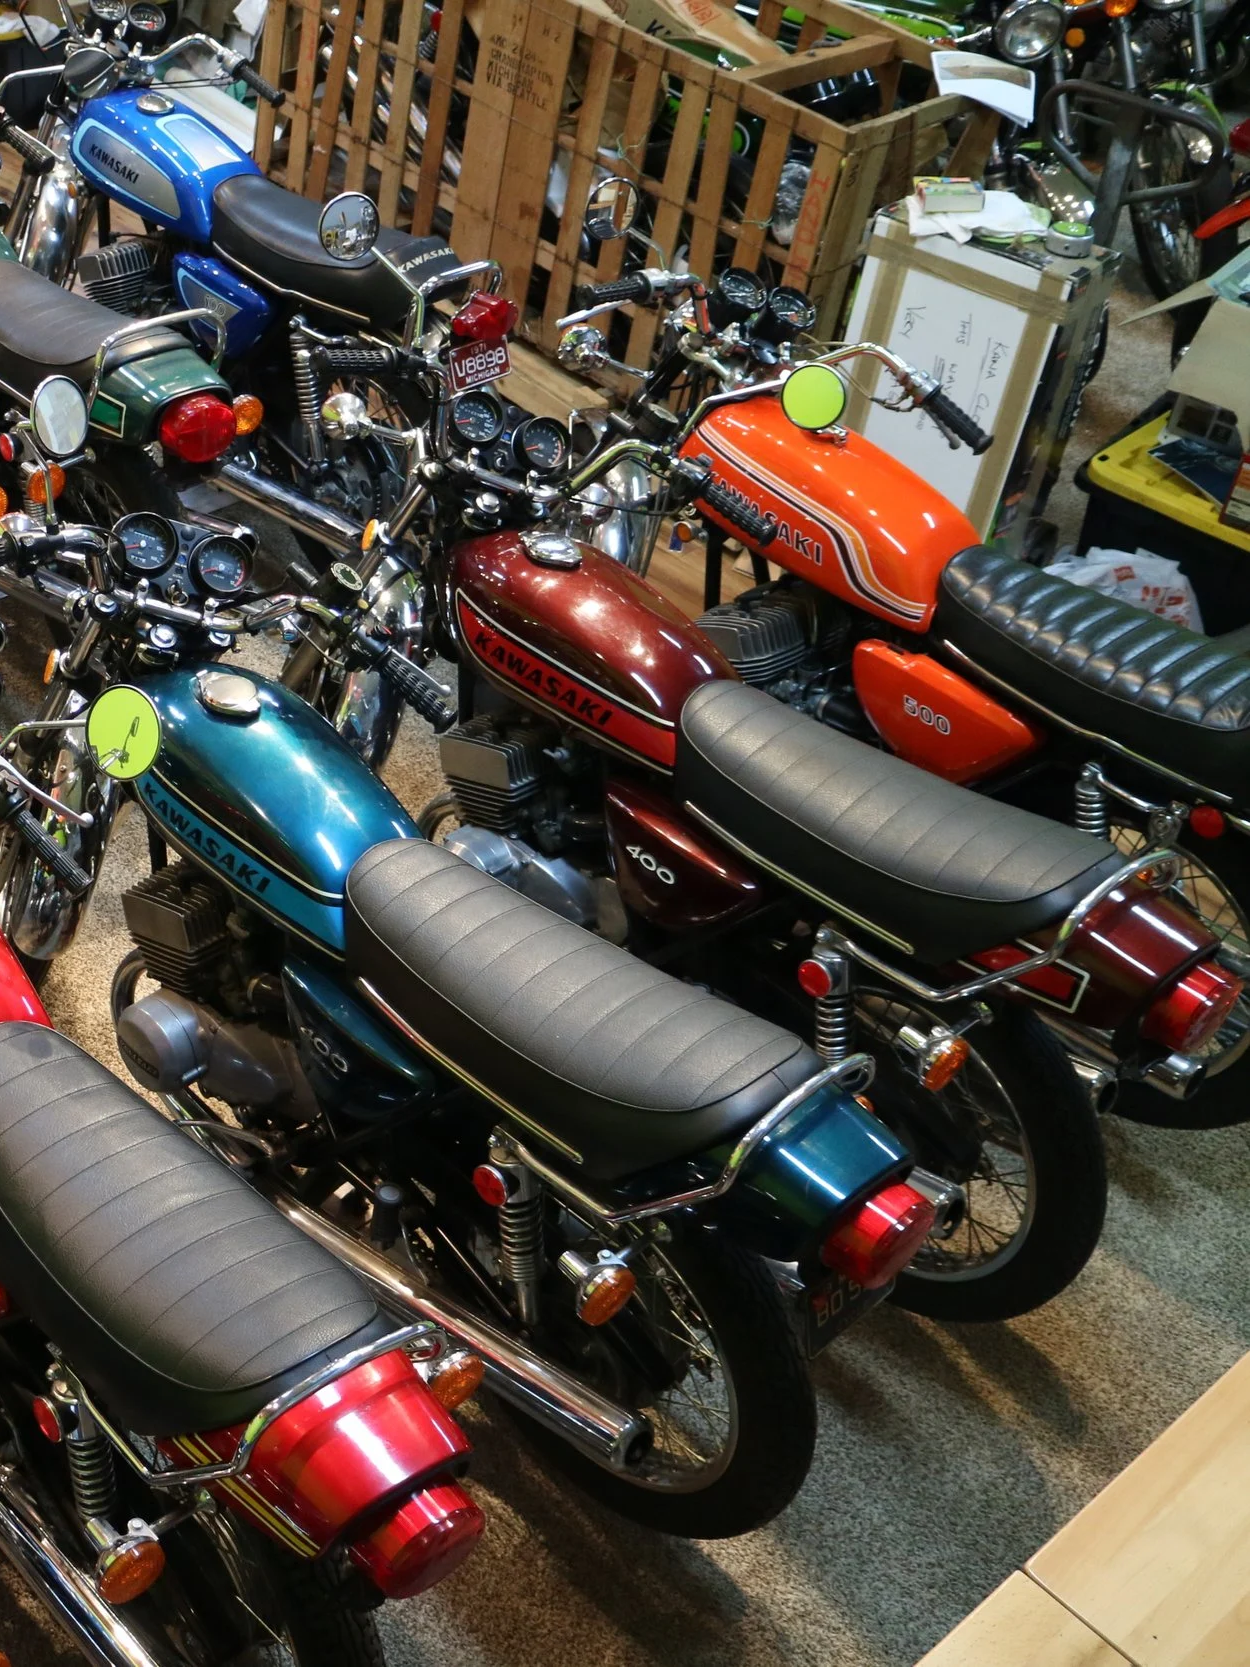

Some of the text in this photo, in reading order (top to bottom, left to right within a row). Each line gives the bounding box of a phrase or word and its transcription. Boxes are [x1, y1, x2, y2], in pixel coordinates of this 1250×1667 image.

[87, 142, 141, 186] KAWASAKI
[398, 247, 455, 274] KAWASAKI
[454, 346, 507, 378] V8898
[465, 366, 501, 384] MICHIGAN
[475, 631, 613, 726] KAWASAKI
[903, 694, 951, 736] 500
[143, 781, 271, 893] KAWASAKI
[626, 843, 676, 886] 400
